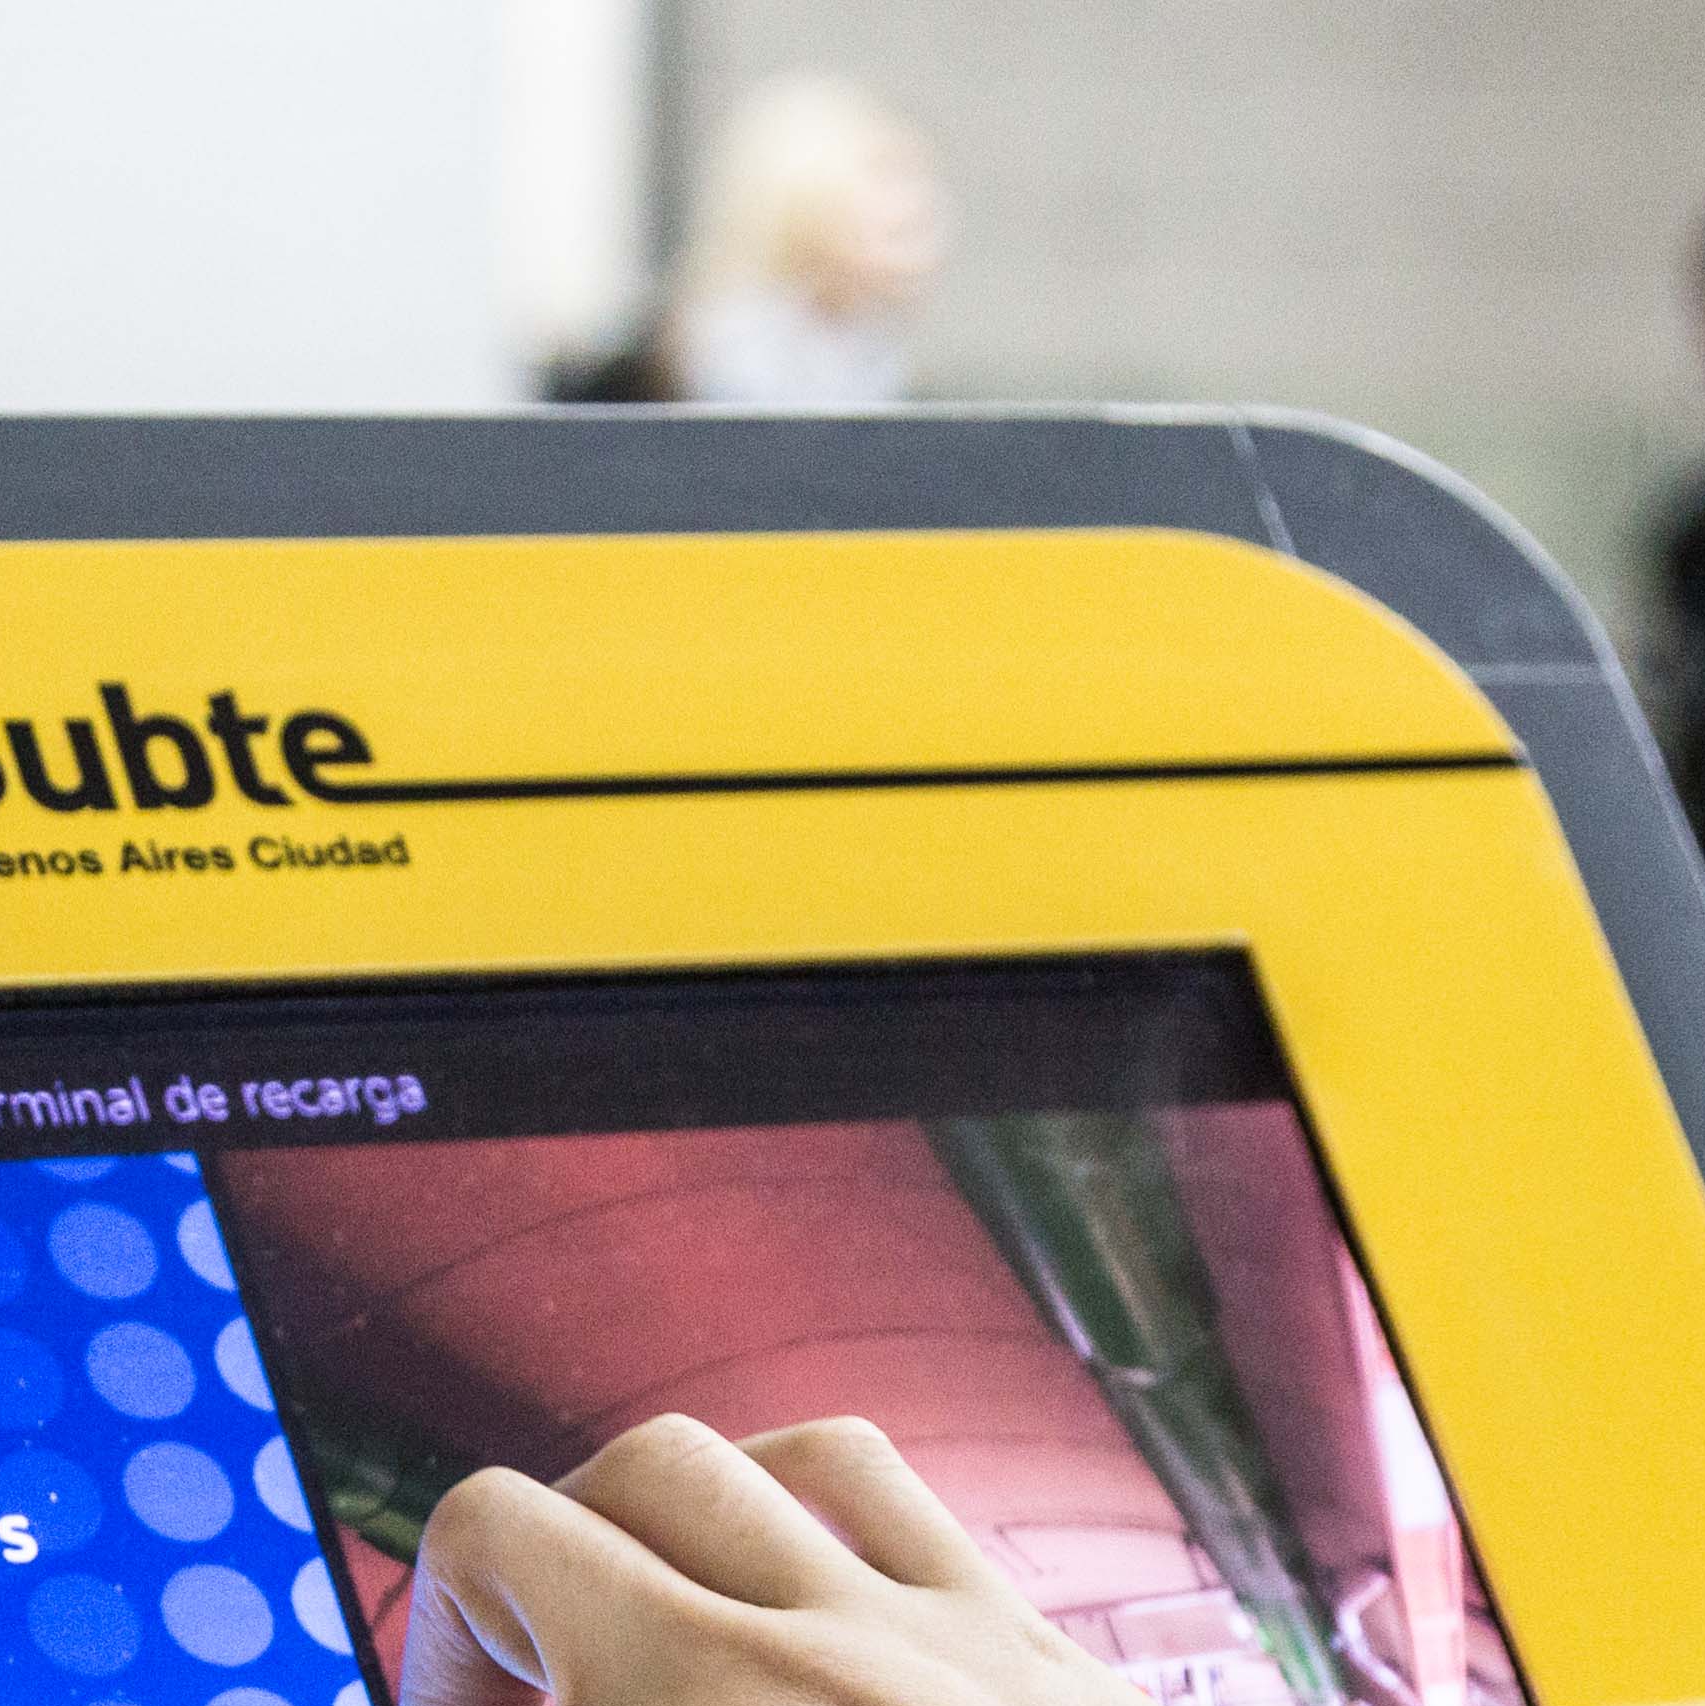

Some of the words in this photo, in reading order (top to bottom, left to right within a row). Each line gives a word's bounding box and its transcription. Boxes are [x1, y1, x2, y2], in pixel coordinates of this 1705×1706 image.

[119, 837, 235, 874] Aires
[248, 831, 411, 870] Ciudad
[164, 1074, 228, 1124] de
[240, 1073, 427, 1125] recarga
